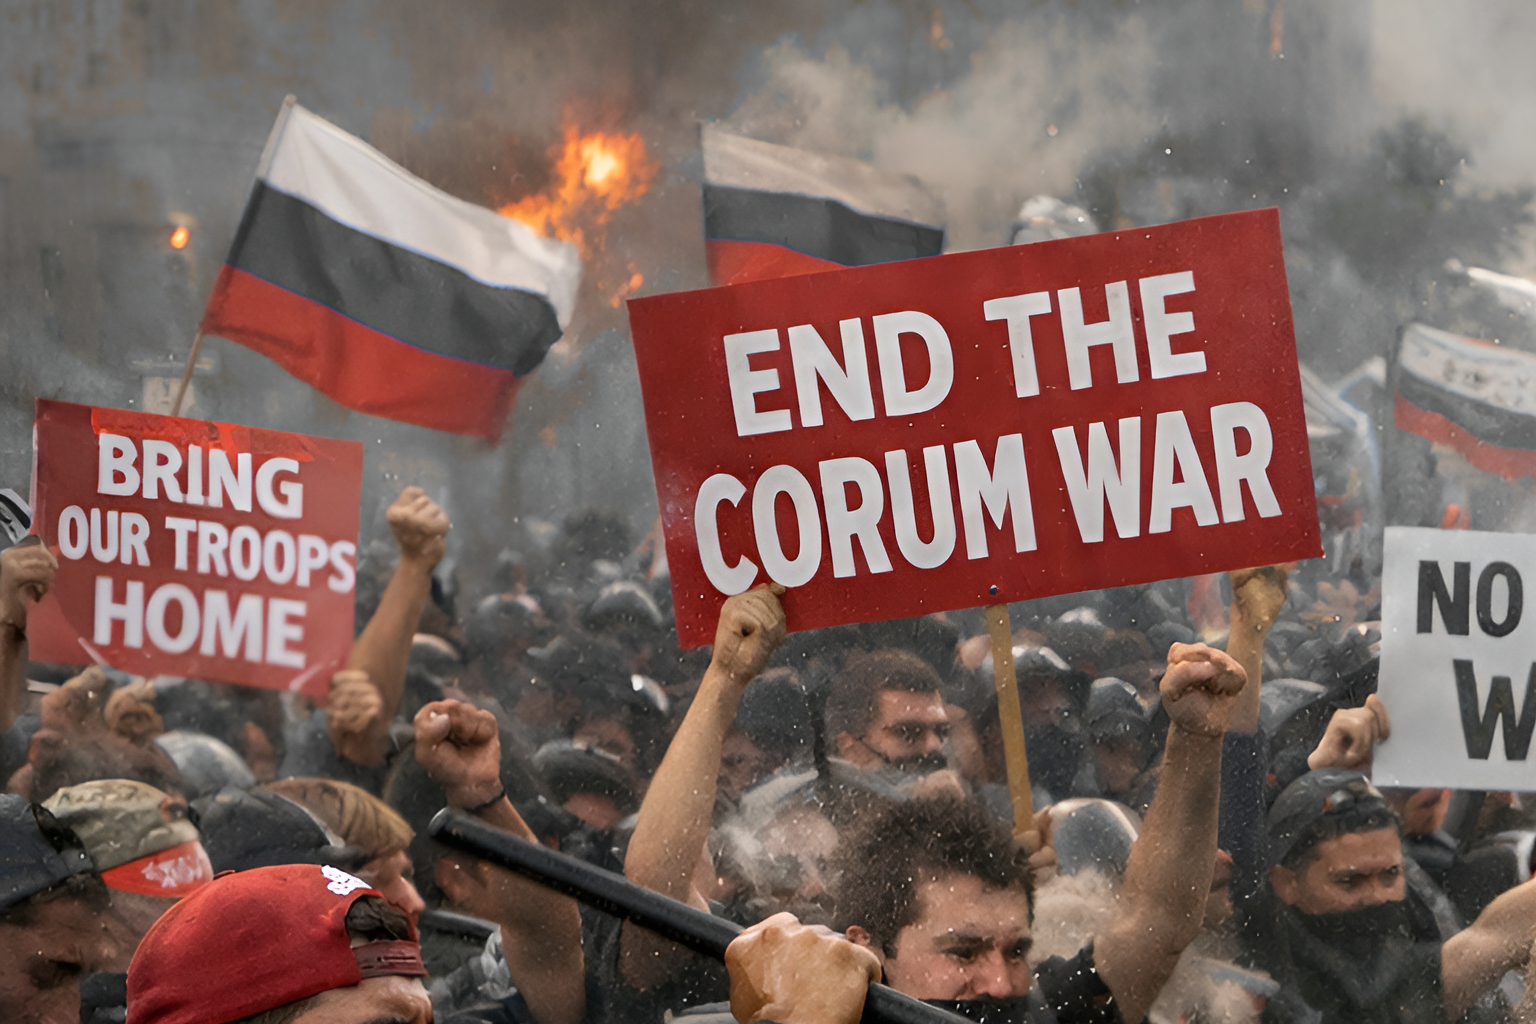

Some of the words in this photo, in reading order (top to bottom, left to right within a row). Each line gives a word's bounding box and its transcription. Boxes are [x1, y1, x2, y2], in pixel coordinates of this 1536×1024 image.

[723, 310, 955, 437] END
[983, 270, 1207, 398] THE
[97, 432, 304, 520] BRING
[694, 432, 1038, 597] CORUM
[1051, 401, 1283, 544] WAR
[57, 505, 151, 566] OUR
[164, 516, 357, 594] TROOPS
[93, 576, 308, 669] HOME
[1416, 559, 1524, 637] NO
